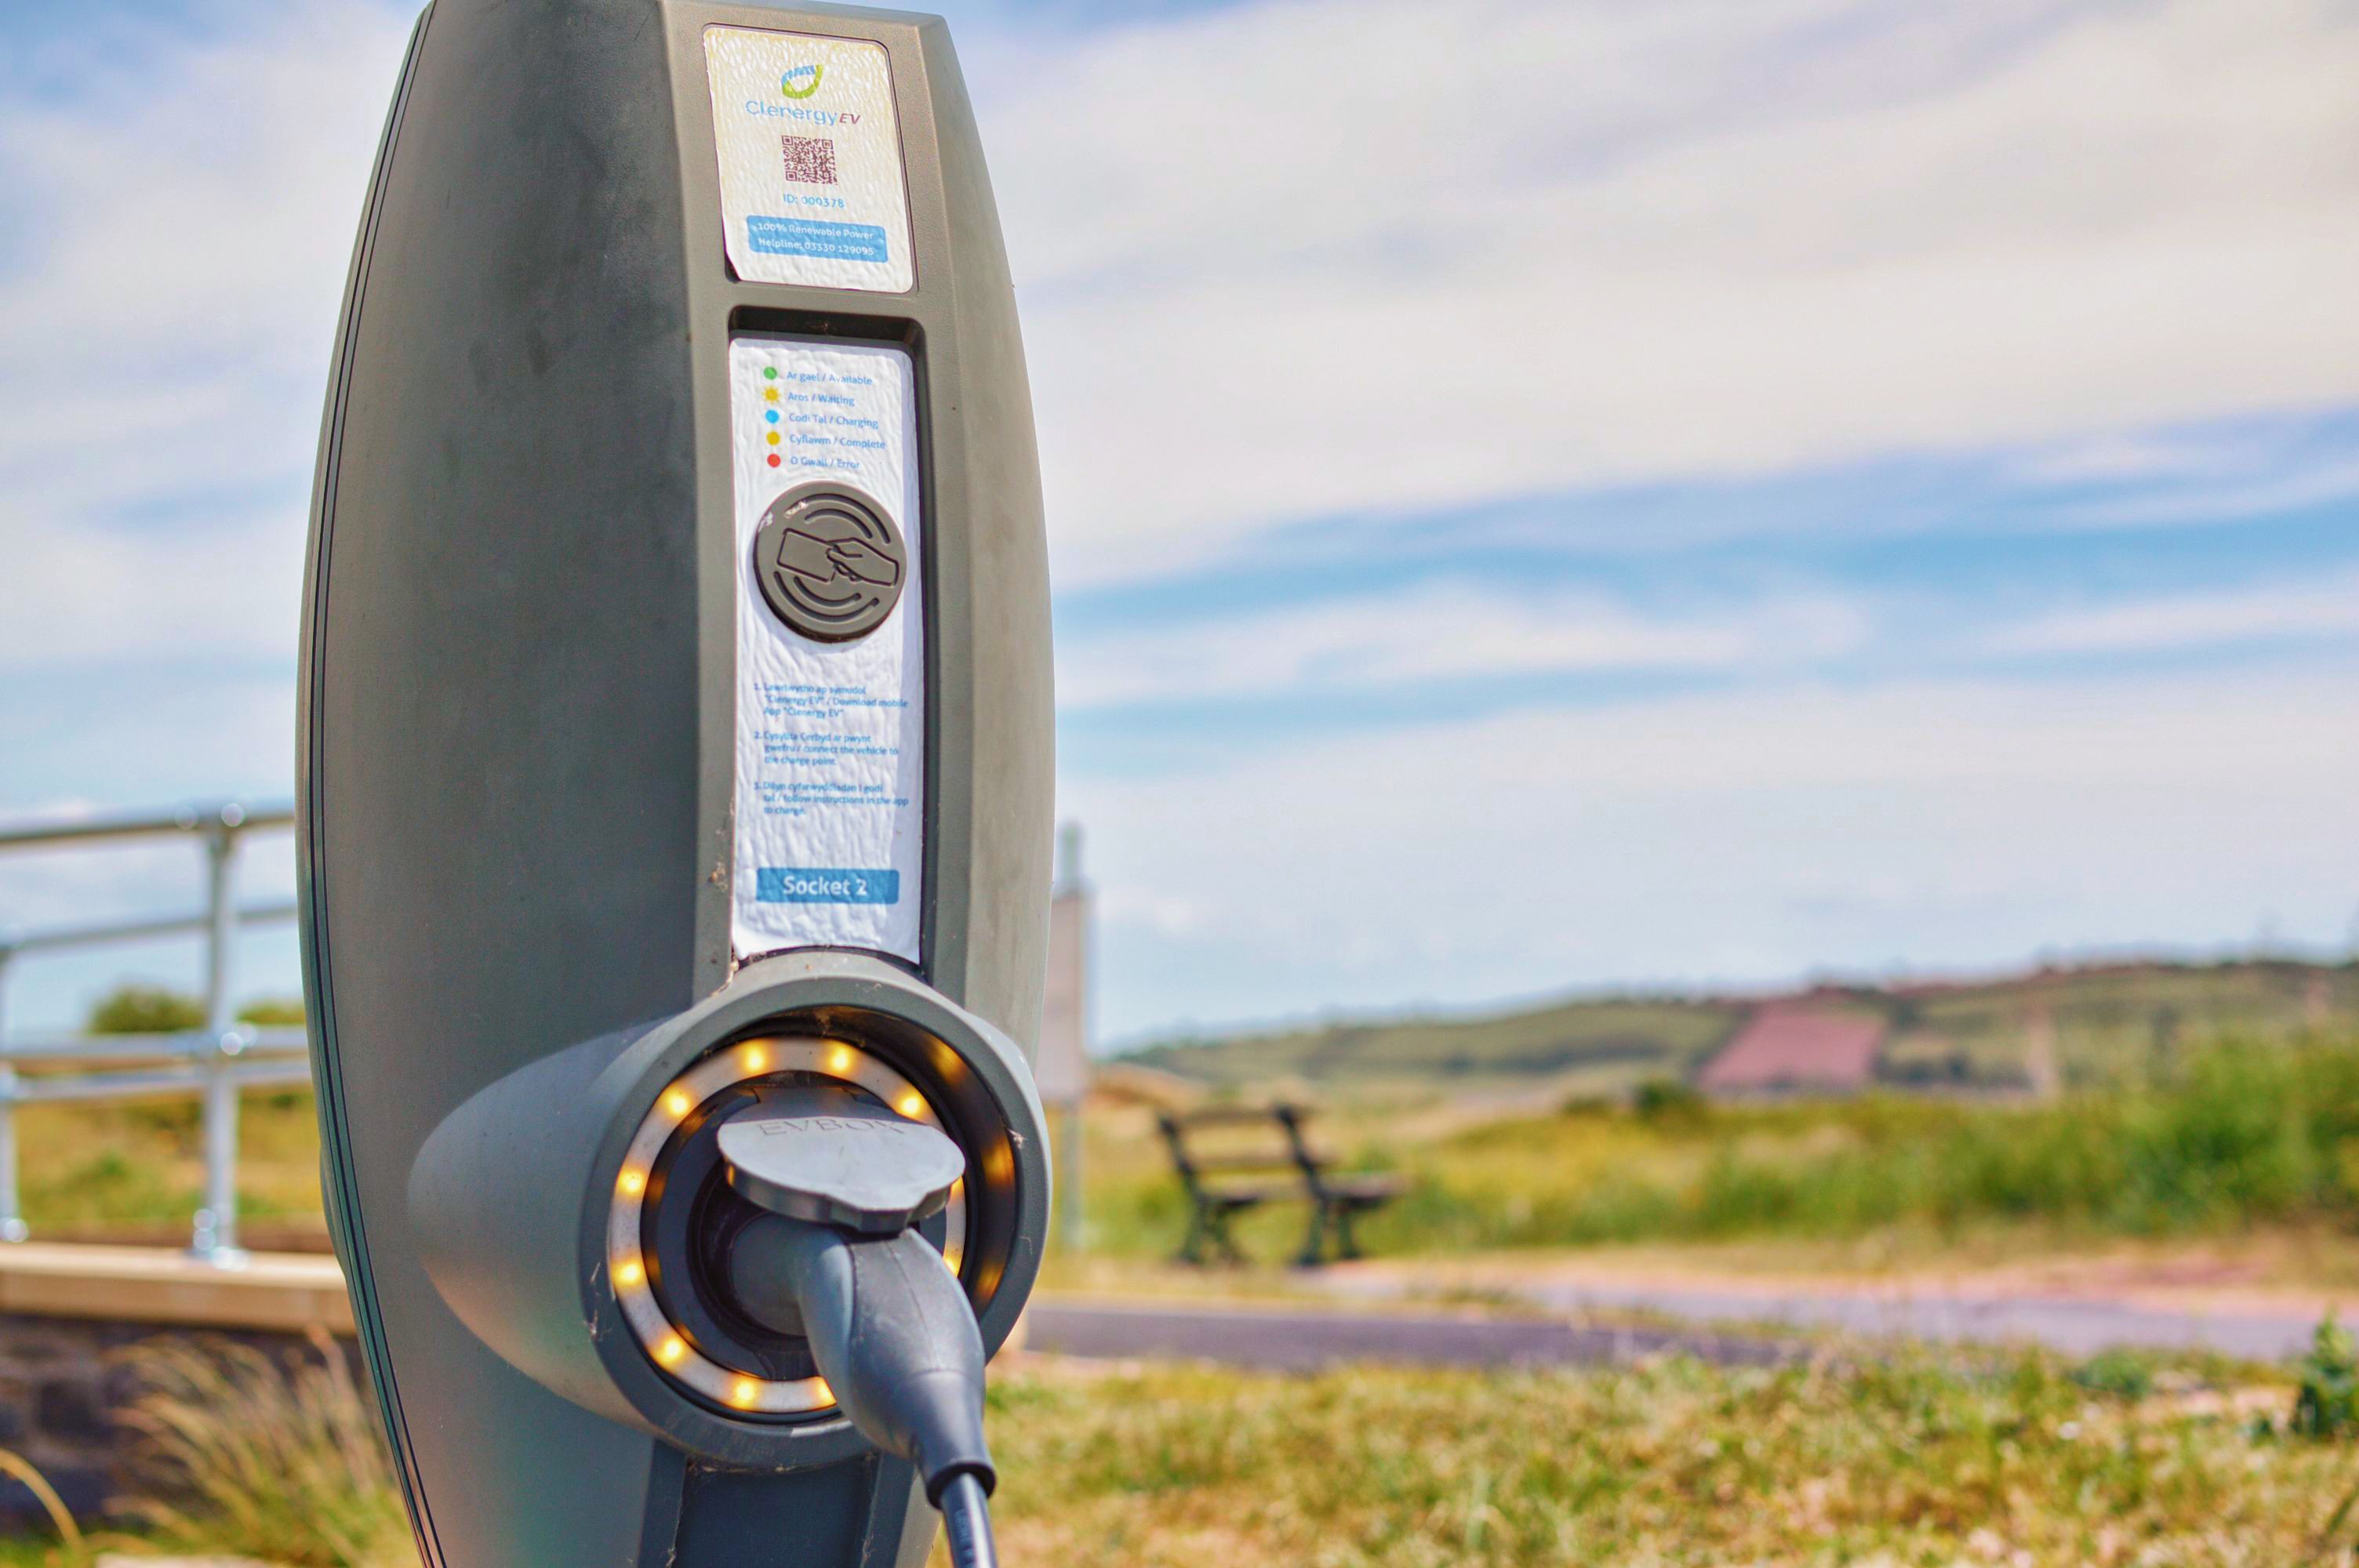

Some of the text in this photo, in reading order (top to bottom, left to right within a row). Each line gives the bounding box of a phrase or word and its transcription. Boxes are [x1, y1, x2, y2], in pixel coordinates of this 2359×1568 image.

[745, 100, 861, 126] Clenergy EV
[782, 194, 798, 205] ID:
[758, 222, 874, 240] 100% Renewable Power
[758, 237, 803, 250] Helpline:
[805, 241, 835, 252] 03330
[787, 371, 798, 379] Ar
[800, 372, 822, 383] gael
[829, 374, 873, 385] Available
[787, 392, 809, 401] Aros
[818, 394, 856, 407] Waiting
[789, 412, 811, 423] Codi
[812, 414, 827, 424] Tal
[836, 416, 879, 430] Charging
[840, 437, 886, 450] Complete
[837, 458, 860, 470] Error
[833, 696, 877, 706] Download
[878, 699, 908, 708] mobile
[856, 746, 887, 755] vehicle
[813, 795, 864, 804] instructions
[893, 797, 909, 808] app
[783, 875, 868, 896] Socket 2
